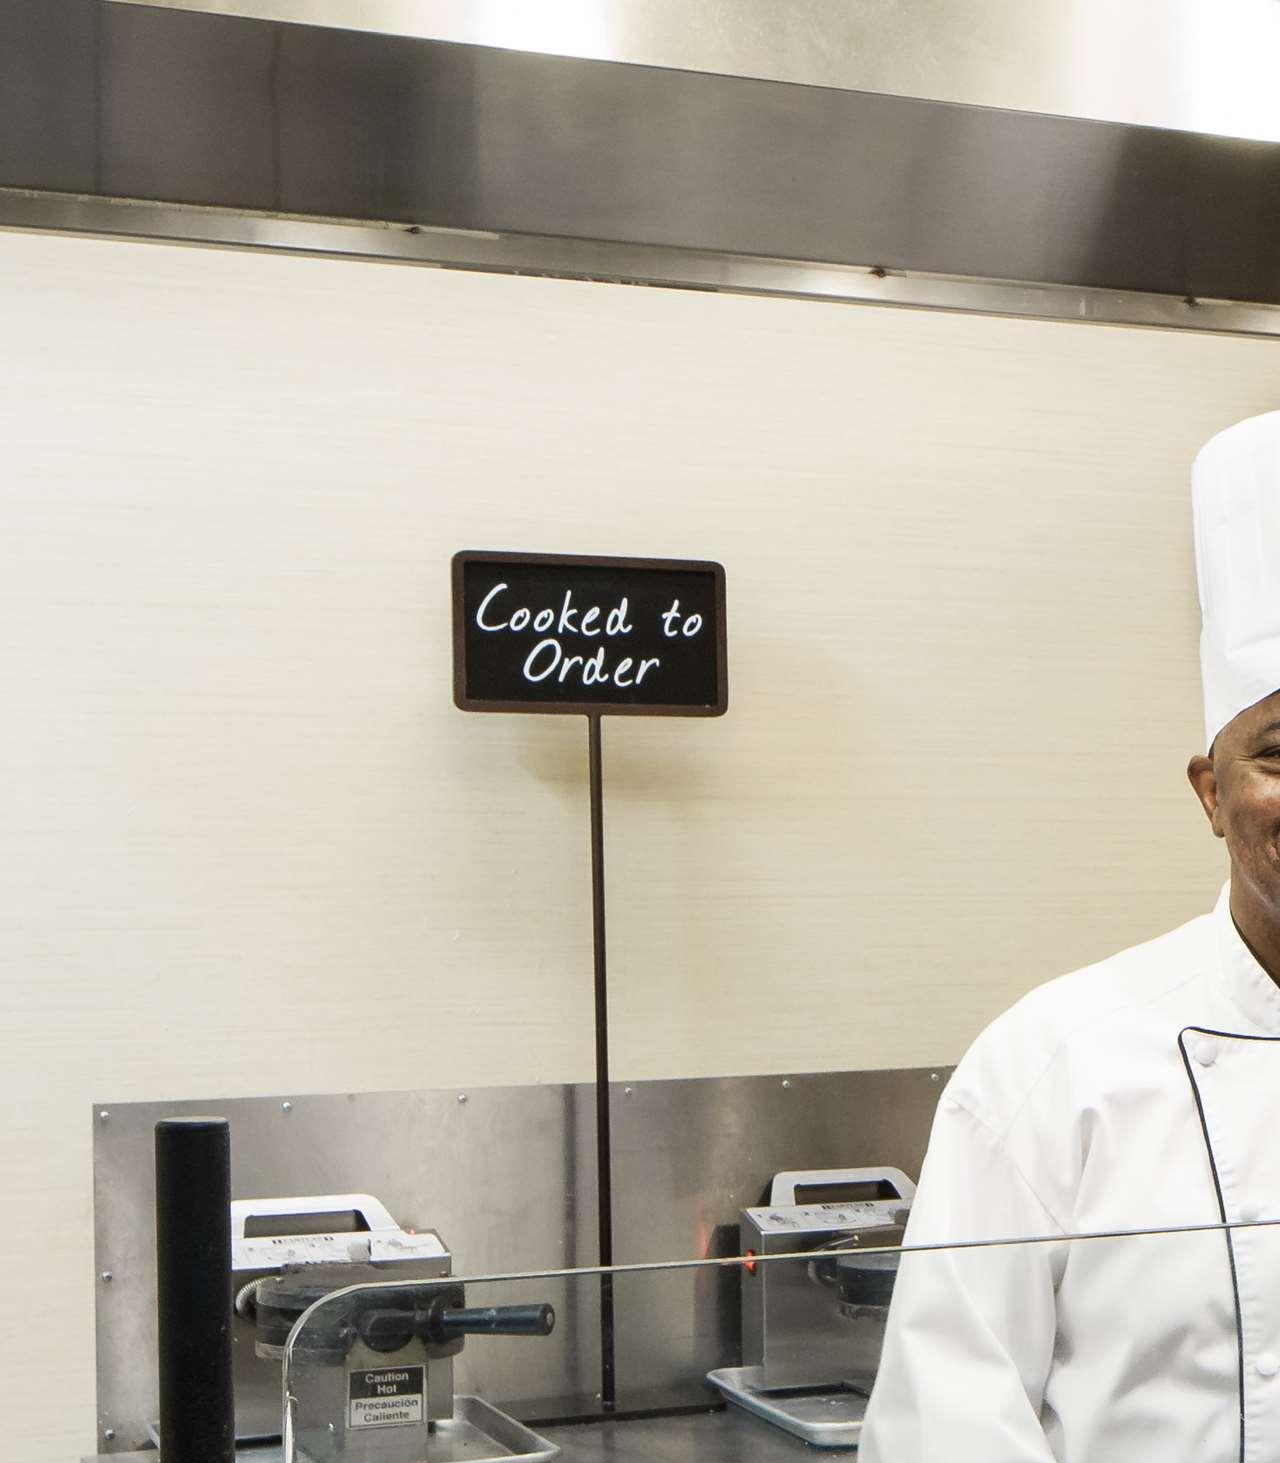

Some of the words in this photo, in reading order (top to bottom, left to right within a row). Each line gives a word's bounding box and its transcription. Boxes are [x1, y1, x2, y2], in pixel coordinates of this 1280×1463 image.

[475, 583, 633, 637] Cooked
[661, 599, 702, 637] to
[523, 638, 660, 687] Order
[365, 1372, 409, 1384] Caution
[377, 1384, 398, 1395] Hot
[363, 1411, 410, 1423] Caliente
